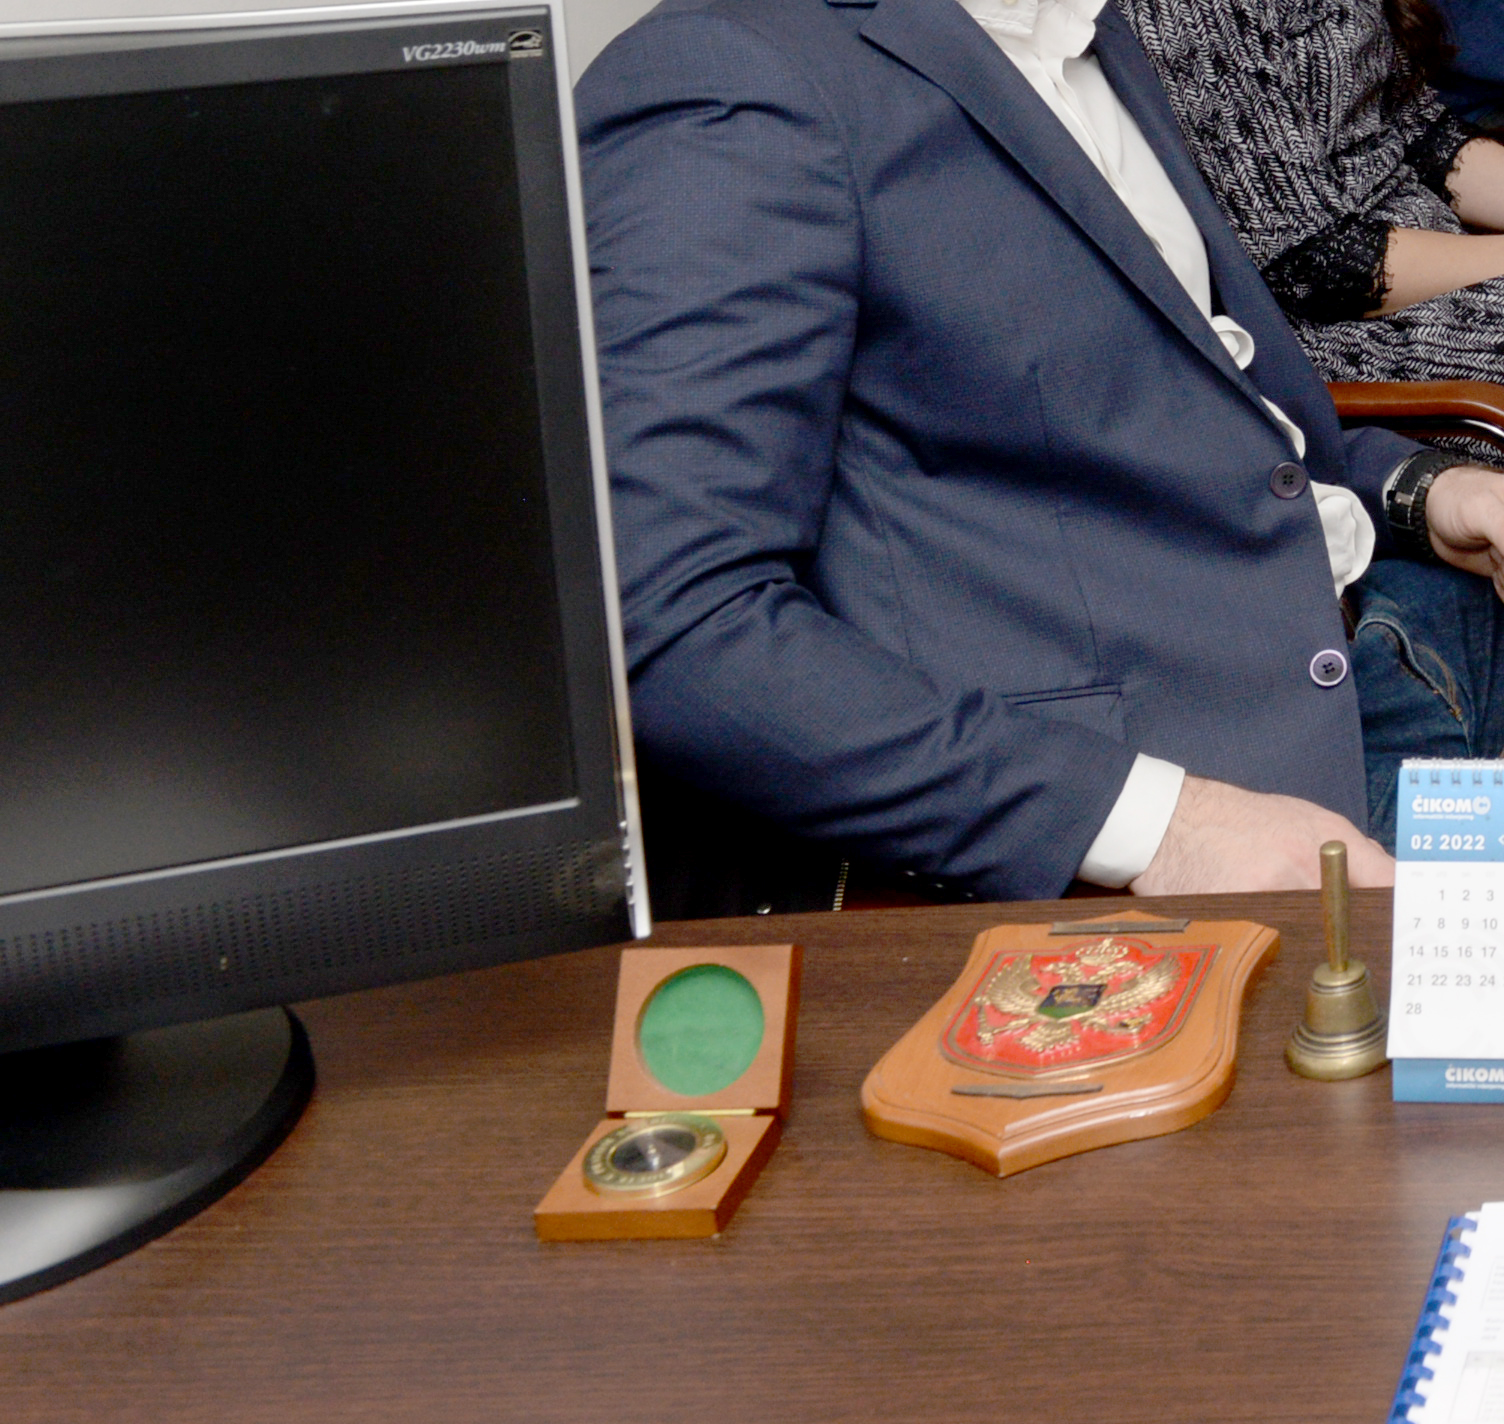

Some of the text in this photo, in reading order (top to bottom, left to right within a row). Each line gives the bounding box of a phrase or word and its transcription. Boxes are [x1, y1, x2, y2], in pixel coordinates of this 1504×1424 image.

[402, 40, 506, 63] VG2230wm
[1411, 794, 1473, 813] ČIKOM
[1410, 834, 1433, 851] 02
[1439, 834, 1486, 851] 2022
[1439, 890, 1444, 900] 1
[1463, 890, 1470, 901] 2
[1487, 890, 1494, 901] 3
[1414, 918, 1421, 929] 7
[1438, 918, 1445, 929] 8
[1462, 918, 1469, 929] 9
[1483, 918, 1498, 930] 10
[1410, 946, 1424, 956] 14
[1434, 946, 1448, 957] 15
[1458, 947, 1472, 958] 16
[1482, 947, 1496, 958] 17
[1408, 975, 1422, 986] 21
[1432, 975, 1447, 986] 22
[1456, 975, 1471, 986] 23
[1480, 975, 1495, 986] 24
[1406, 1003, 1422, 1014] 28
